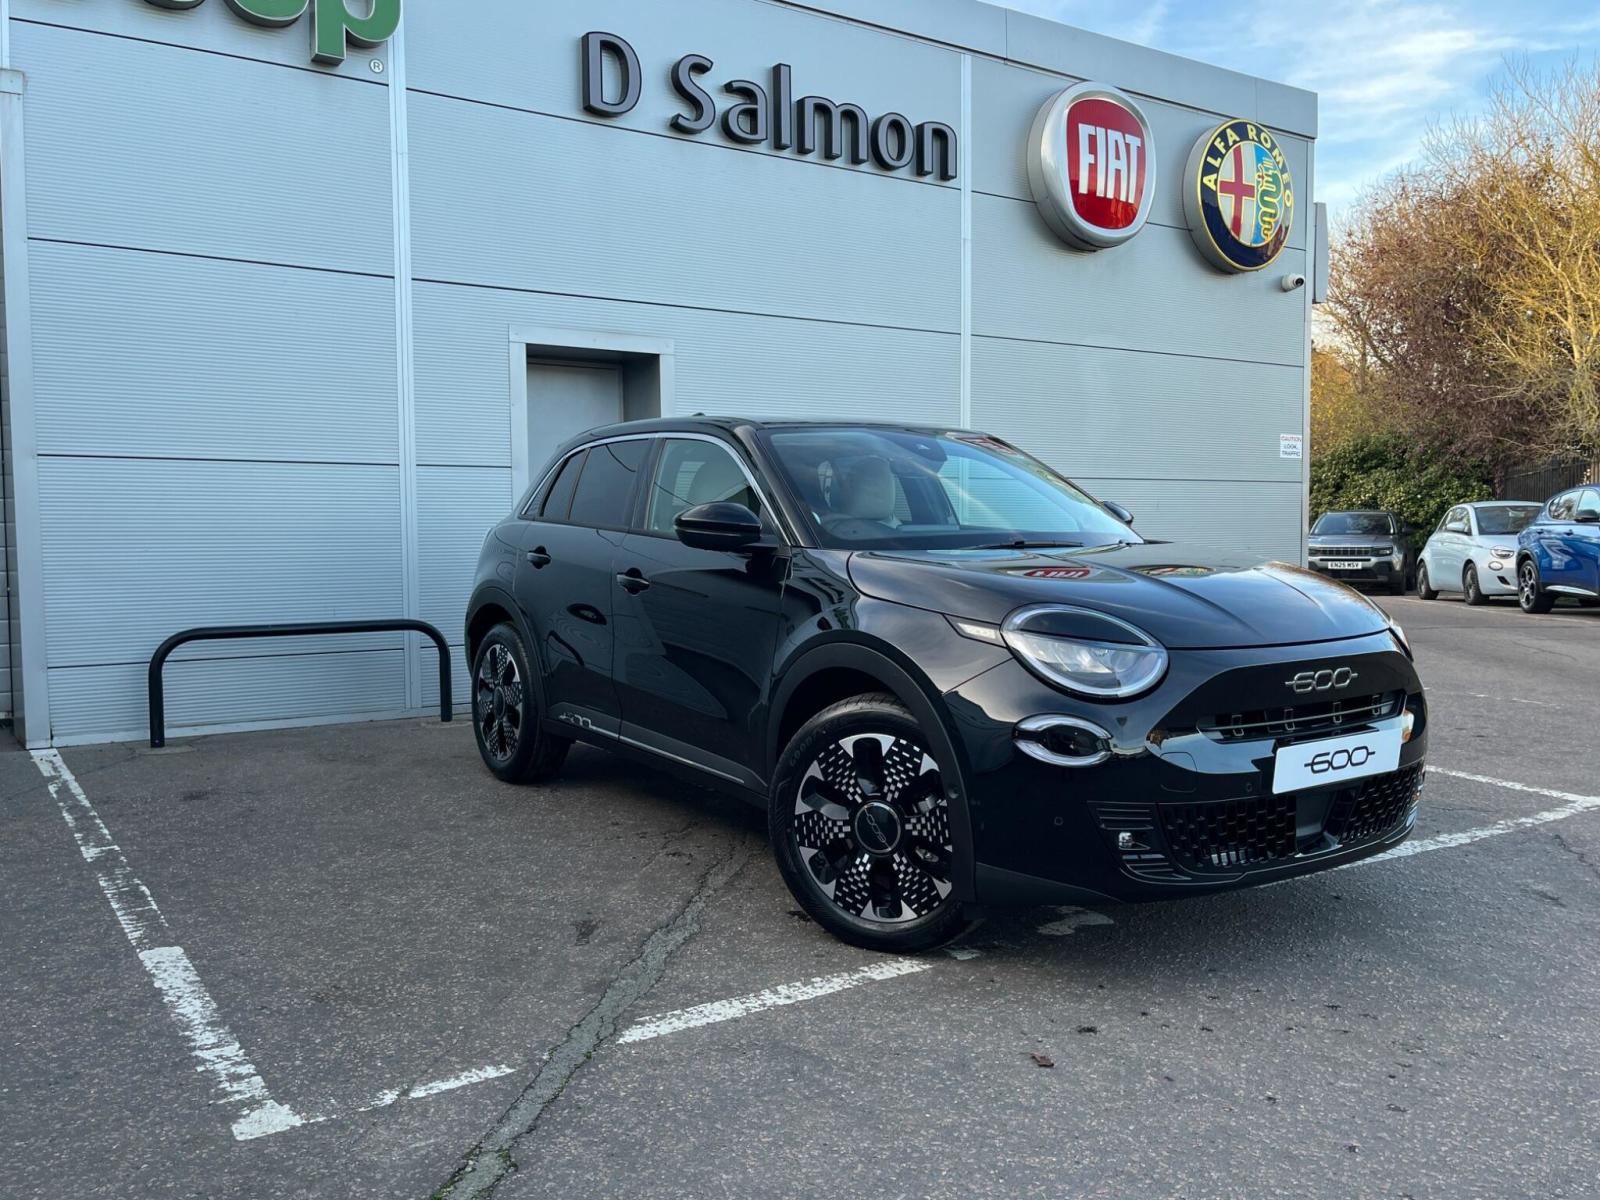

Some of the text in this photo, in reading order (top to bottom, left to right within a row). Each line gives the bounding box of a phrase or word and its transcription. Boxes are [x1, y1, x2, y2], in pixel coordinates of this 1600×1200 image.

[581, 31, 957, 181] D Salmon
[1078, 123, 1142, 205] FIAT
[1202, 123, 1293, 207] ALFA ROMEO
[1292, 667, 1353, 692] 600
[1308, 745, 1372, 775] 600
